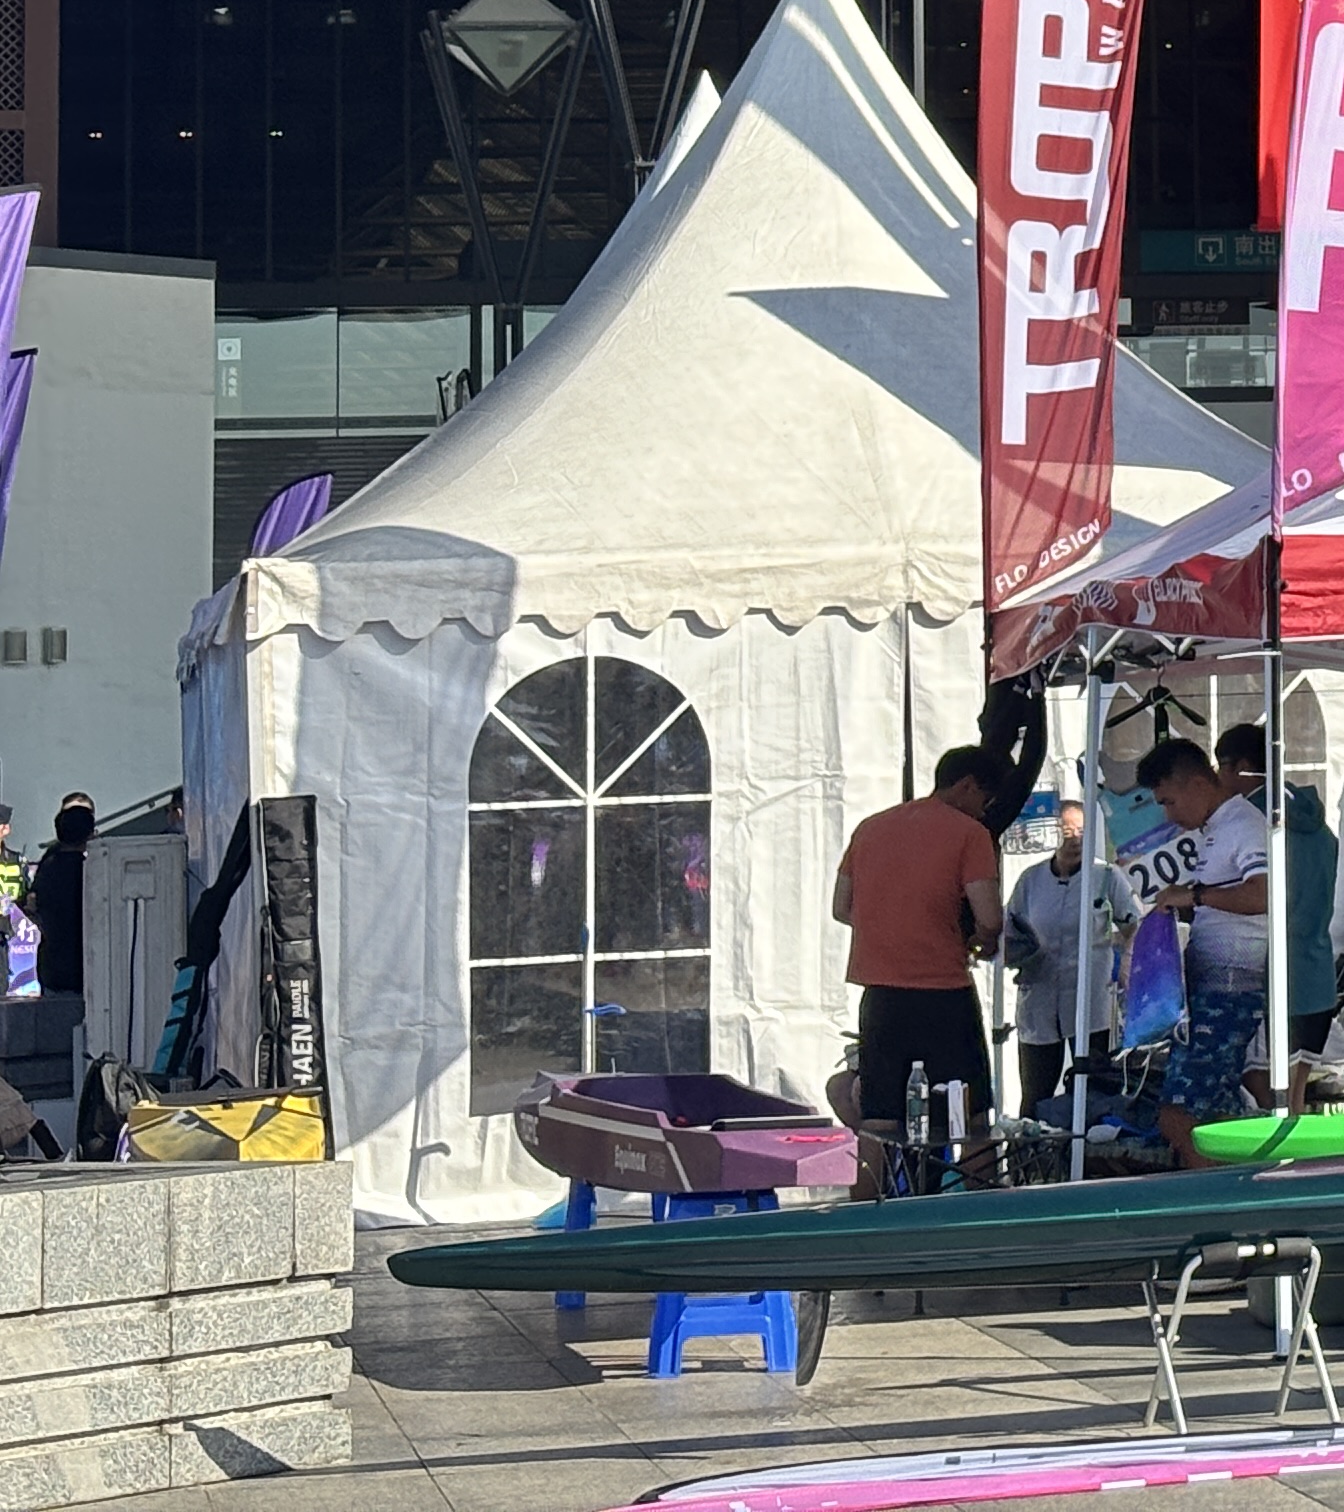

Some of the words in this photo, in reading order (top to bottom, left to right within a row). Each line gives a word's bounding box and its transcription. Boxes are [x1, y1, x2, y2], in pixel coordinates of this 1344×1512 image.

[994, 564, 1028, 595] FLO
[1038, 517, 1101, 569] DESIGN
[1128, 837, 1199, 899] 208
